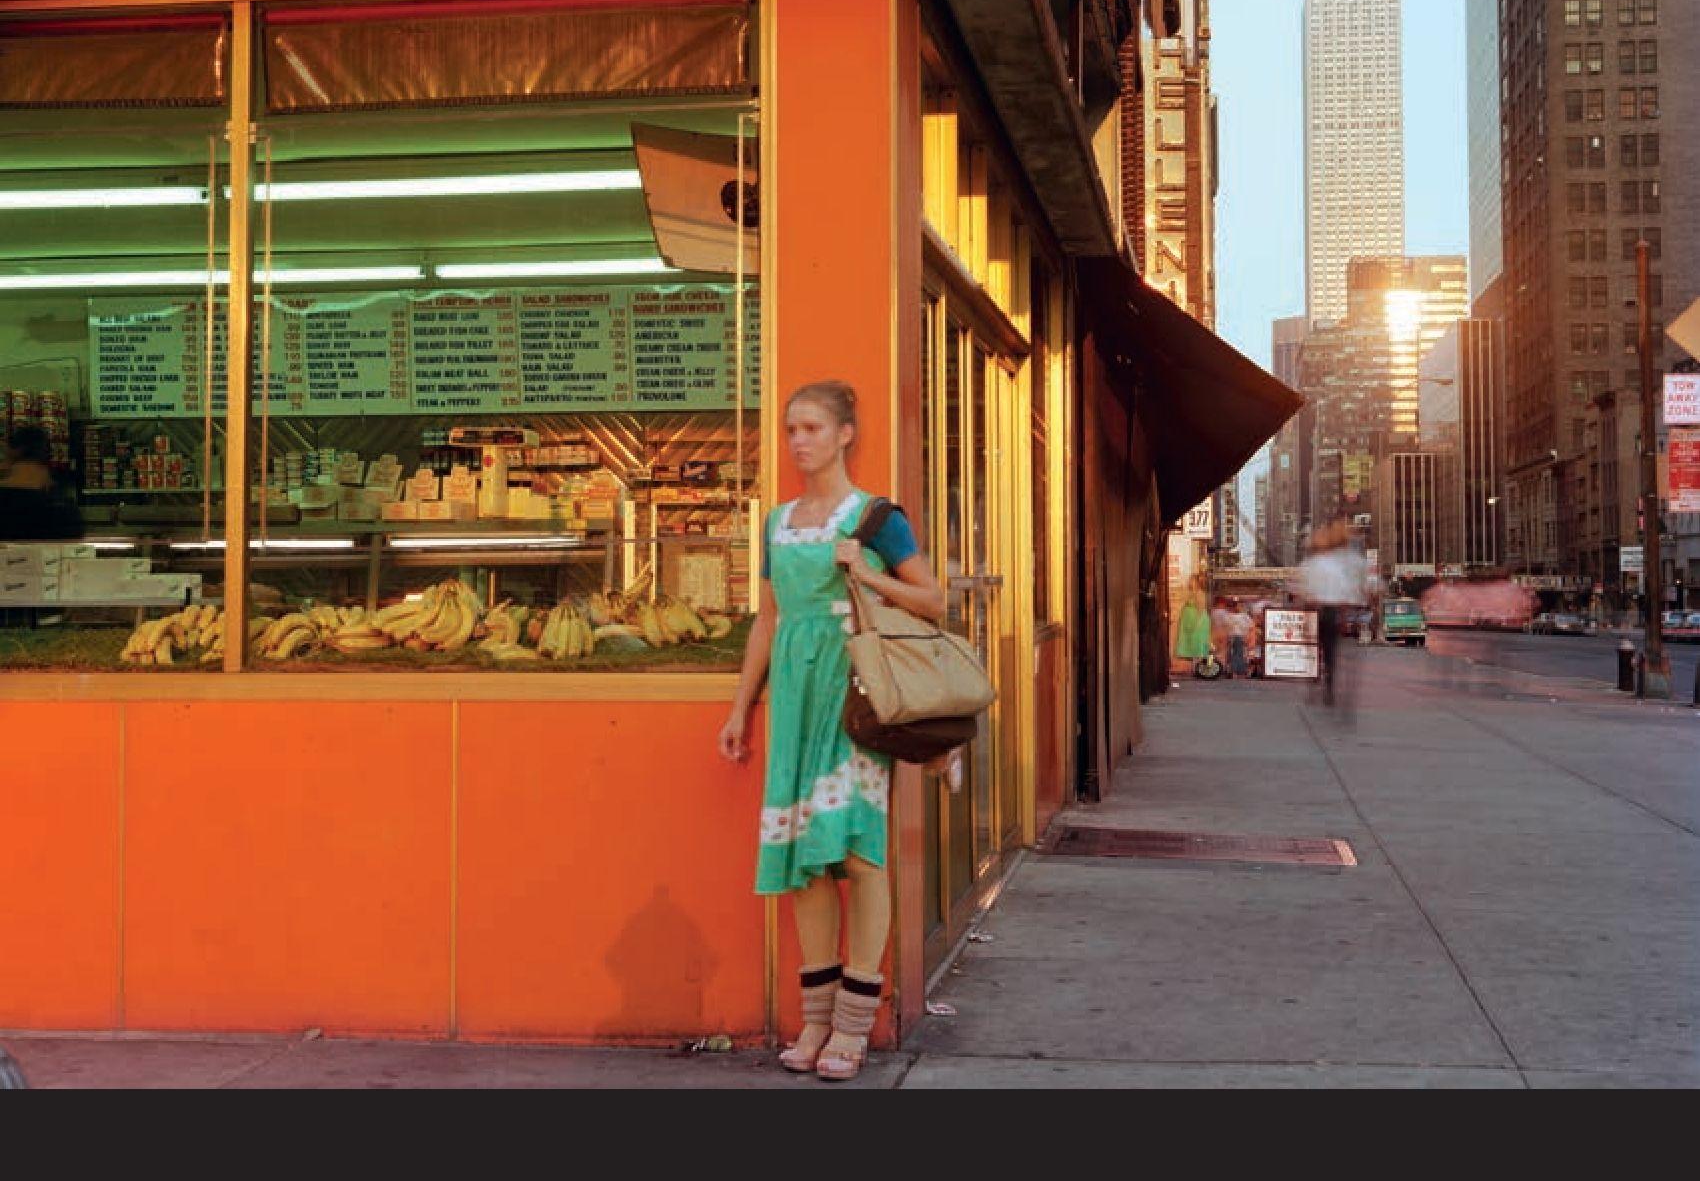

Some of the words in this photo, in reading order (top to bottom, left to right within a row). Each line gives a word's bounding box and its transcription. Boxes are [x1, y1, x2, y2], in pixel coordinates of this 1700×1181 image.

[1672, 381, 1696, 390] TOW
[1668, 394, 1697, 402] AWAY
[1668, 405, 1697, 415] ZONE
